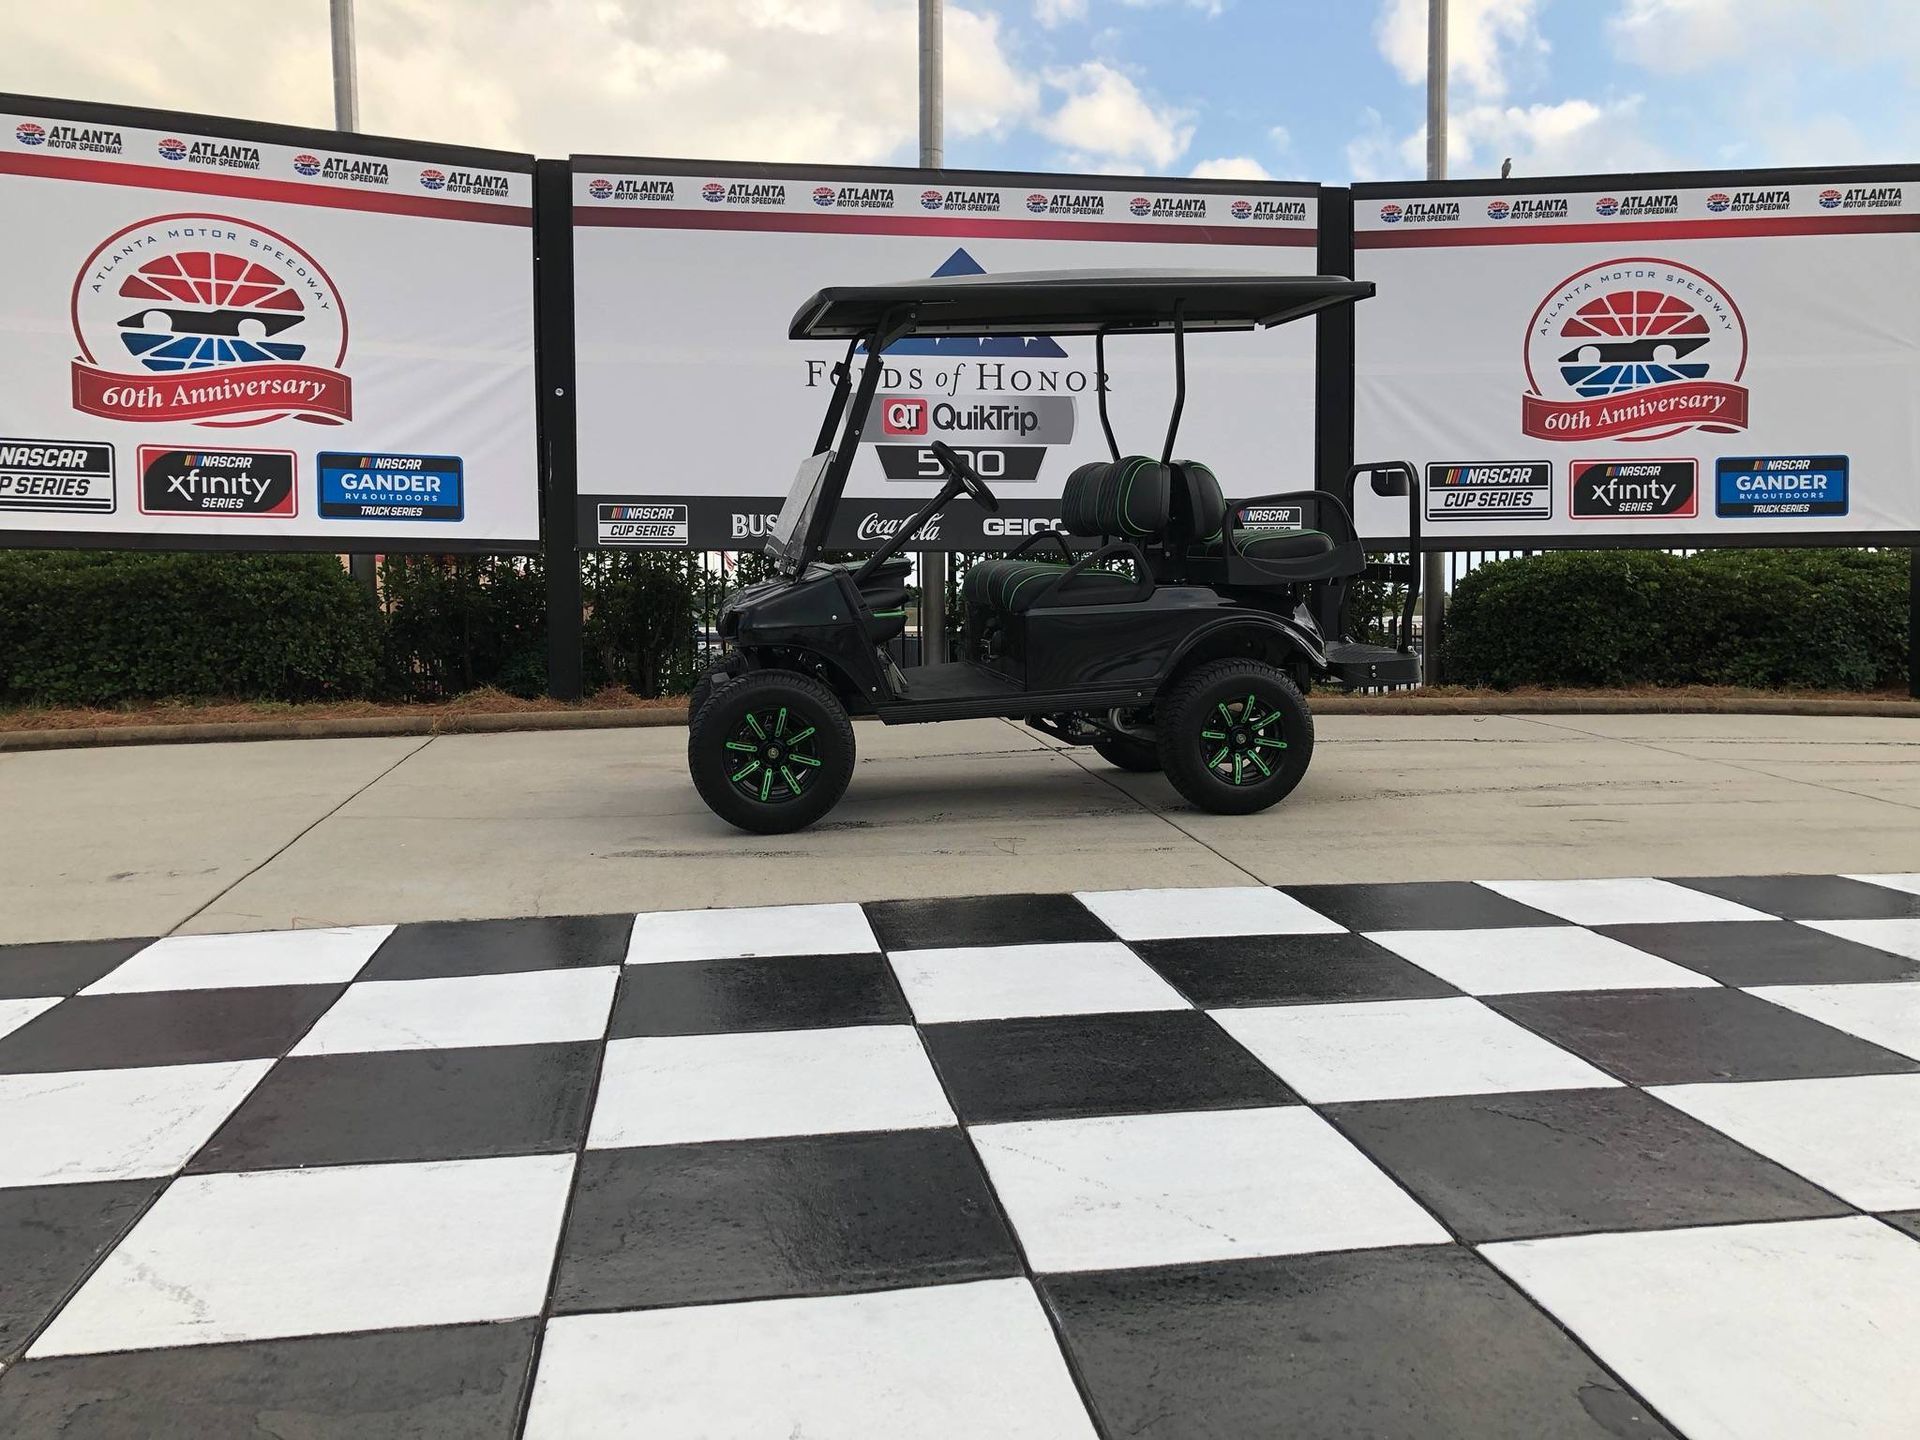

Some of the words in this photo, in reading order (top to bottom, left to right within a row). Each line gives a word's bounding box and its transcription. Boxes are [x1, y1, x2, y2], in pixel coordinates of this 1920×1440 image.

[50, 126, 122, 146] ATLANTA
[47, 140, 78, 150] MOTOR
[79, 143, 121, 155] SPEEDWAY
[190, 142, 260, 161] ATLANTA
[189, 155, 217, 165] MOTOR
[218, 157, 259, 170] SPEEDWAY
[323, 158, 388, 176] ATLANTA
[322, 170, 349, 180] MOTOR
[350, 173, 388, 185] SPEEDWAY
[448, 172, 508, 189] ATLANTA
[447, 184, 472, 194] MOTOR
[473, 187, 508, 198] SPEEDWAY
[616, 180, 674, 194] ATLANTA
[729, 184, 785, 197] ATLANTA
[614, 192, 639, 201] MOTOR
[639, 193, 674, 202] SPEEDWAY
[727, 196, 751, 204] MOTOR
[751, 197, 785, 205] SPEEDWAY
[838, 187, 894, 201] ATLANTA
[945, 191, 1000, 204] ATLANTA
[1732, 191, 1790, 204] ATLANTA
[1845, 188, 1902, 202] ATLANTA
[837, 199, 860, 208] MOTOR
[860, 200, 894, 209] SPEEDWAY
[944, 203, 967, 211] MOTOR
[967, 204, 1000, 212] SPEEDWAY
[1050, 194, 1104, 208] ATLANTA
[1153, 198, 1206, 211] ATLANTA
[1254, 201, 1306, 214] ATLANTA
[1512, 199, 1568, 212] ATLANTA
[1621, 195, 1678, 209] ATLANTA
[1731, 203, 1754, 212] MOTOR
[1755, 202, 1790, 211] SPEEDWAY
[1843, 200, 1867, 209] MOTOR
[1867, 199, 1901, 208] SPEEDWAY
[1049, 206, 1072, 214] MOTOR
[1072, 207, 1104, 215] SPEEDWAY
[1152, 209, 1174, 218] MOTOR
[1174, 210, 1206, 219] SPEEDWAY
[1405, 203, 1460, 216] ATLANTA
[1511, 211, 1533, 220] MOTOR
[1533, 210, 1567, 219] SPEEDWAY
[1620, 206, 1643, 215] MOTOR
[1644, 205, 1678, 214] SPEEDWAY
[1253, 212, 1275, 221] MOTOR
[1275, 213, 1306, 221] SPEEDWAY
[1404, 214, 1426, 222] MOTOR
[1427, 213, 1459, 222] SPEEDWAY
[92, 235, 157, 293] ATLANTA
[168, 229, 236, 241] MOTOR
[250, 239, 330, 310] SPEEDWAY
[1540, 283, 1592, 336] ATLANTA
[1600, 270, 1655, 283] MOTOR
[1666, 274, 1732, 331] SPEEDWAY
[805, 360, 923, 389] FDS
[935, 363, 966, 397] of
[976, 363, 1112, 392] HONOR
[102, 386, 163, 408] 60th
[171, 378, 327, 406] Anniversary
[1544, 410, 1592, 430] 60th
[1596, 393, 1726, 425] Anniversary
[888, 403, 922, 431] QT
[932, 403, 1038, 436] QuikTrip
[0, 446, 88, 468] NASCAR
[201, 455, 252, 469] NASCAR
[374, 457, 422, 470] NASCAR
[1619, 466, 1661, 477] NASCAR
[1767, 460, 1811, 471] NASCAR
[1467, 468, 1532, 484] NASCAR
[1736, 474, 1827, 491] GANDER
[14, 476, 91, 496] SERIES
[167, 470, 272, 503] xfinity
[340, 473, 441, 493] GANDER
[1592, 478, 1676, 506] xfinity
[202, 497, 244, 509] SERIES
[1444, 492, 1476, 507] CUP
[1477, 491, 1533, 507] SERIES
[360, 506, 390, 516] TRUCK
[391, 507, 423, 517] SERIES
[627, 507, 674, 520] NASCAR
[1619, 502, 1653, 512] SERIES
[1753, 504, 1779, 514] TRUCK
[1780, 503, 1810, 513] SERIES
[1247, 510, 1290, 521] NASCAR
[610, 525, 634, 537] CUP
[636, 525, 675, 537] SERIES
